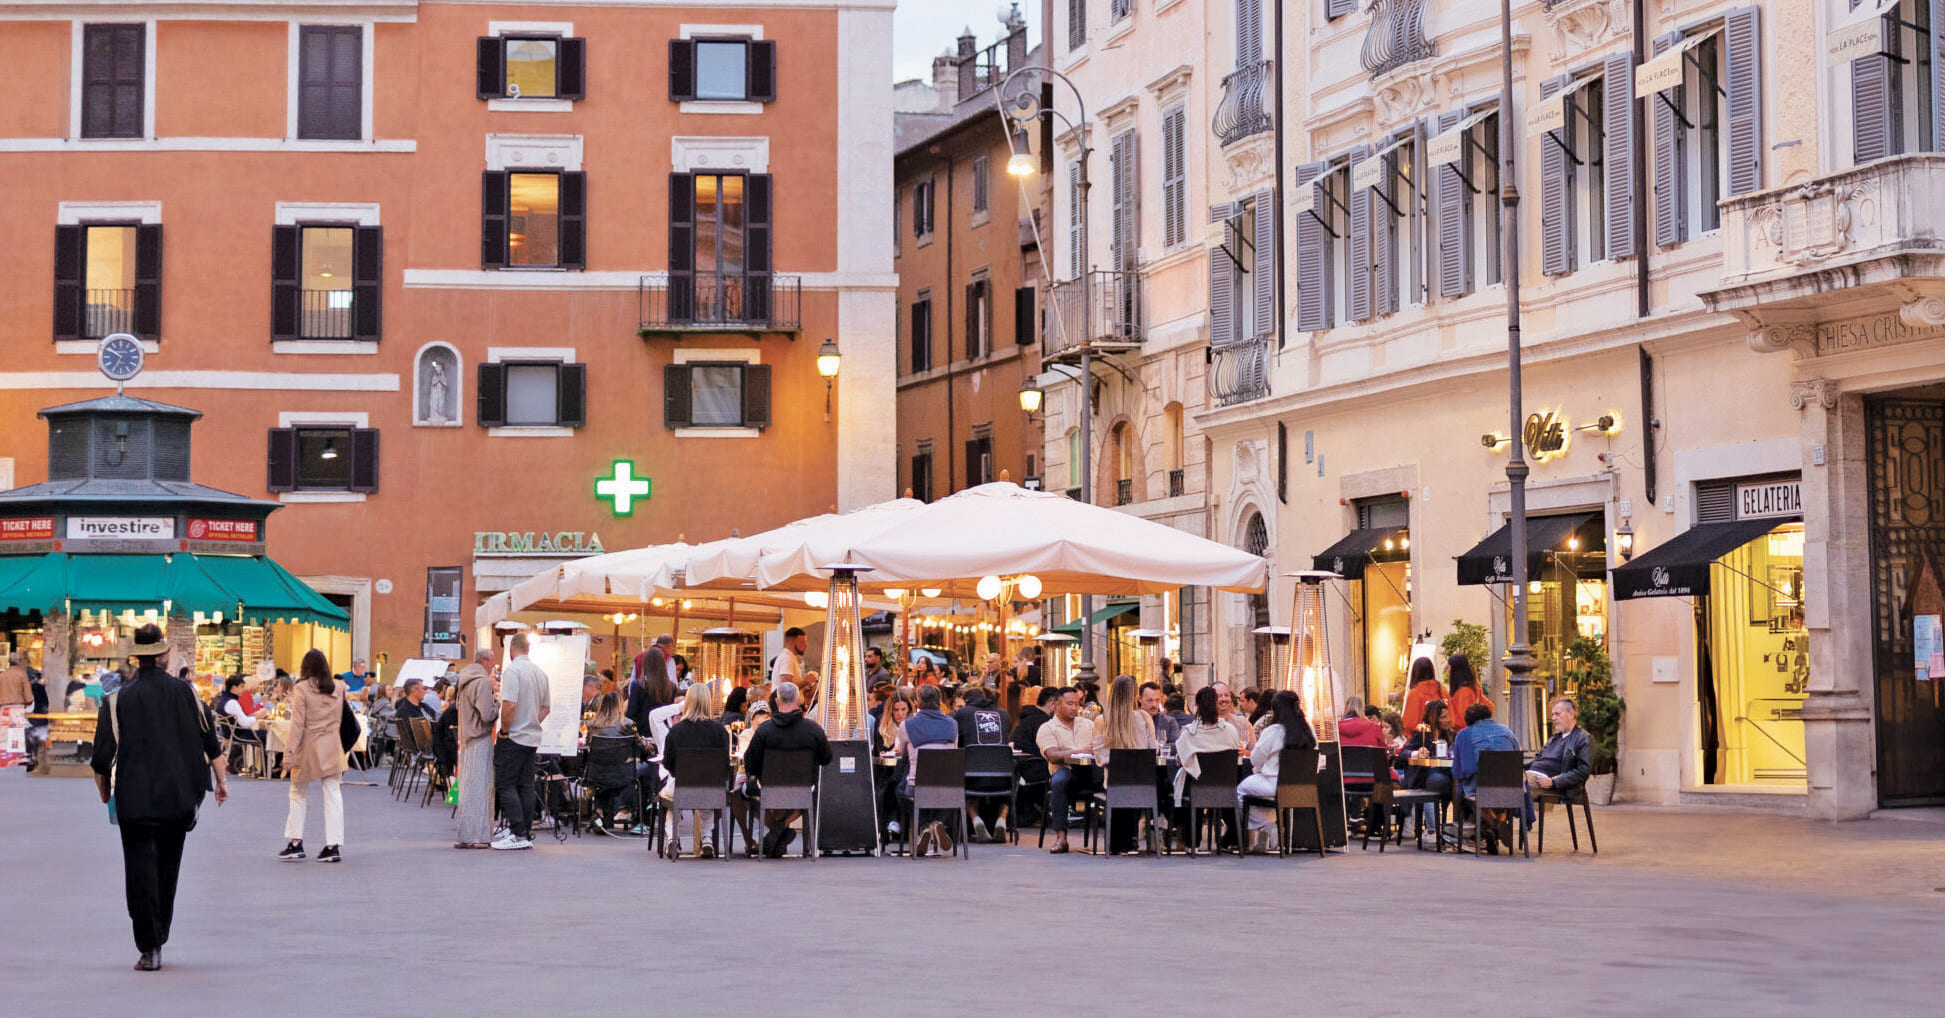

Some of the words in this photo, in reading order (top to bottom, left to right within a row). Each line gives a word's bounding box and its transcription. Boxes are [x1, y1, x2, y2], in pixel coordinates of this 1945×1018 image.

[1819, 321, 1869, 352] CHIESA
[1744, 484, 1801, 514] GELATERIA
[2, 521, 30, 531] TICKET
[31, 519, 52, 530] HERE
[80, 519, 160, 533] investire
[208, 521, 233, 532] TICKET
[235, 522, 254, 532] HERE
[474, 532, 604, 552] IRMACIA
